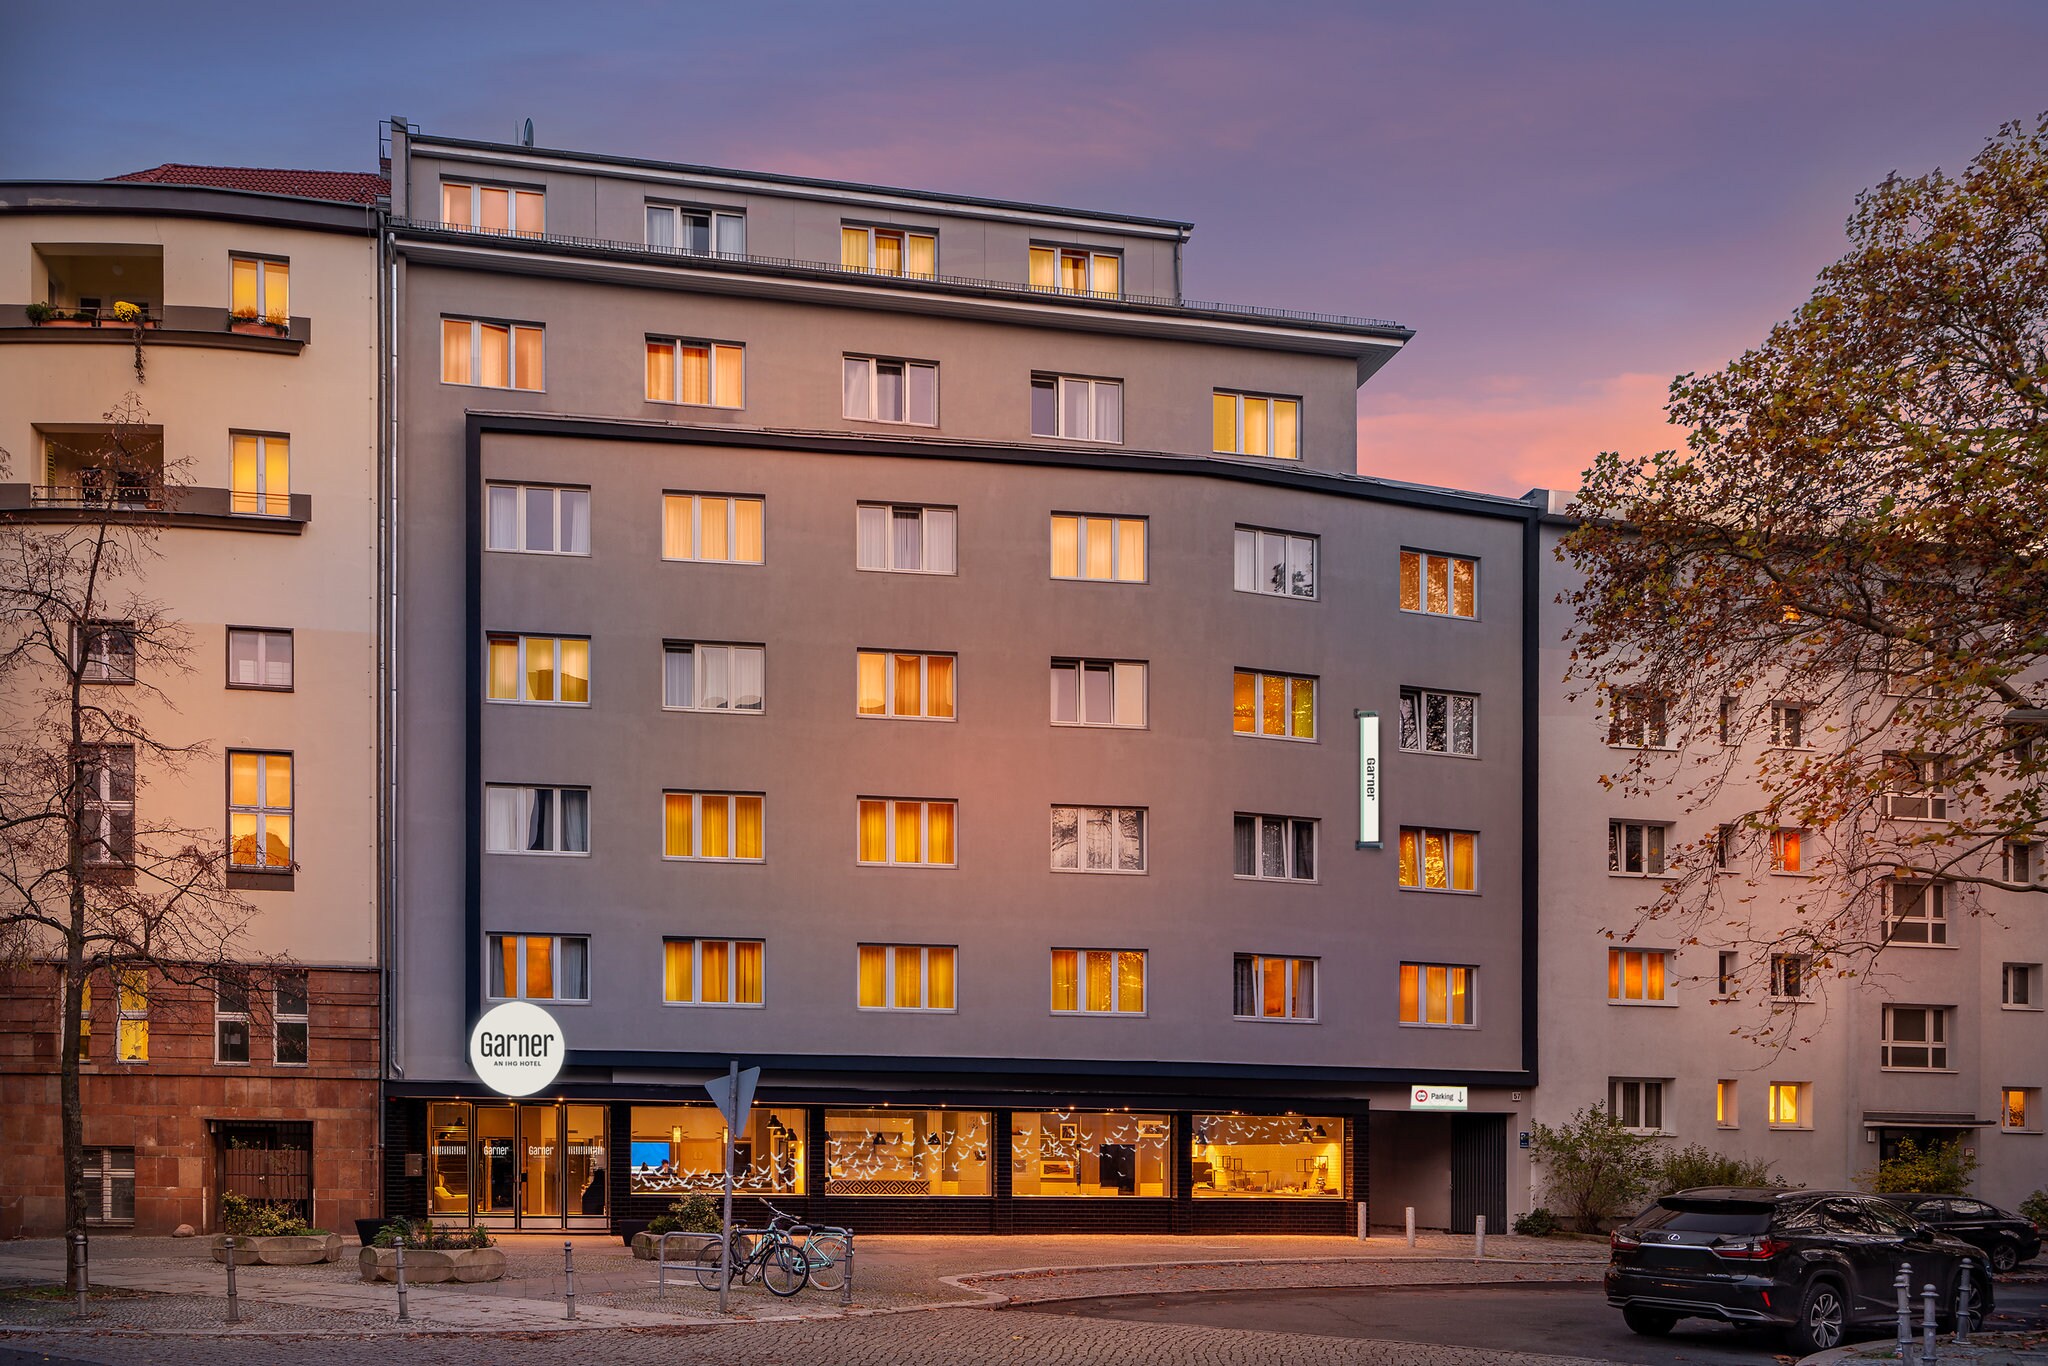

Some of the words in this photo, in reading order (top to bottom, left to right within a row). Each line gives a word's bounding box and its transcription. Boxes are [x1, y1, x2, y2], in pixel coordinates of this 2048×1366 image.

[1366, 757, 1376, 801] Garner
[480, 1031, 555, 1058] Garner
[1431, 1093, 1454, 1101] Parking
[483, 1145, 510, 1156] Garner
[528, 1145, 554, 1156] Garner
